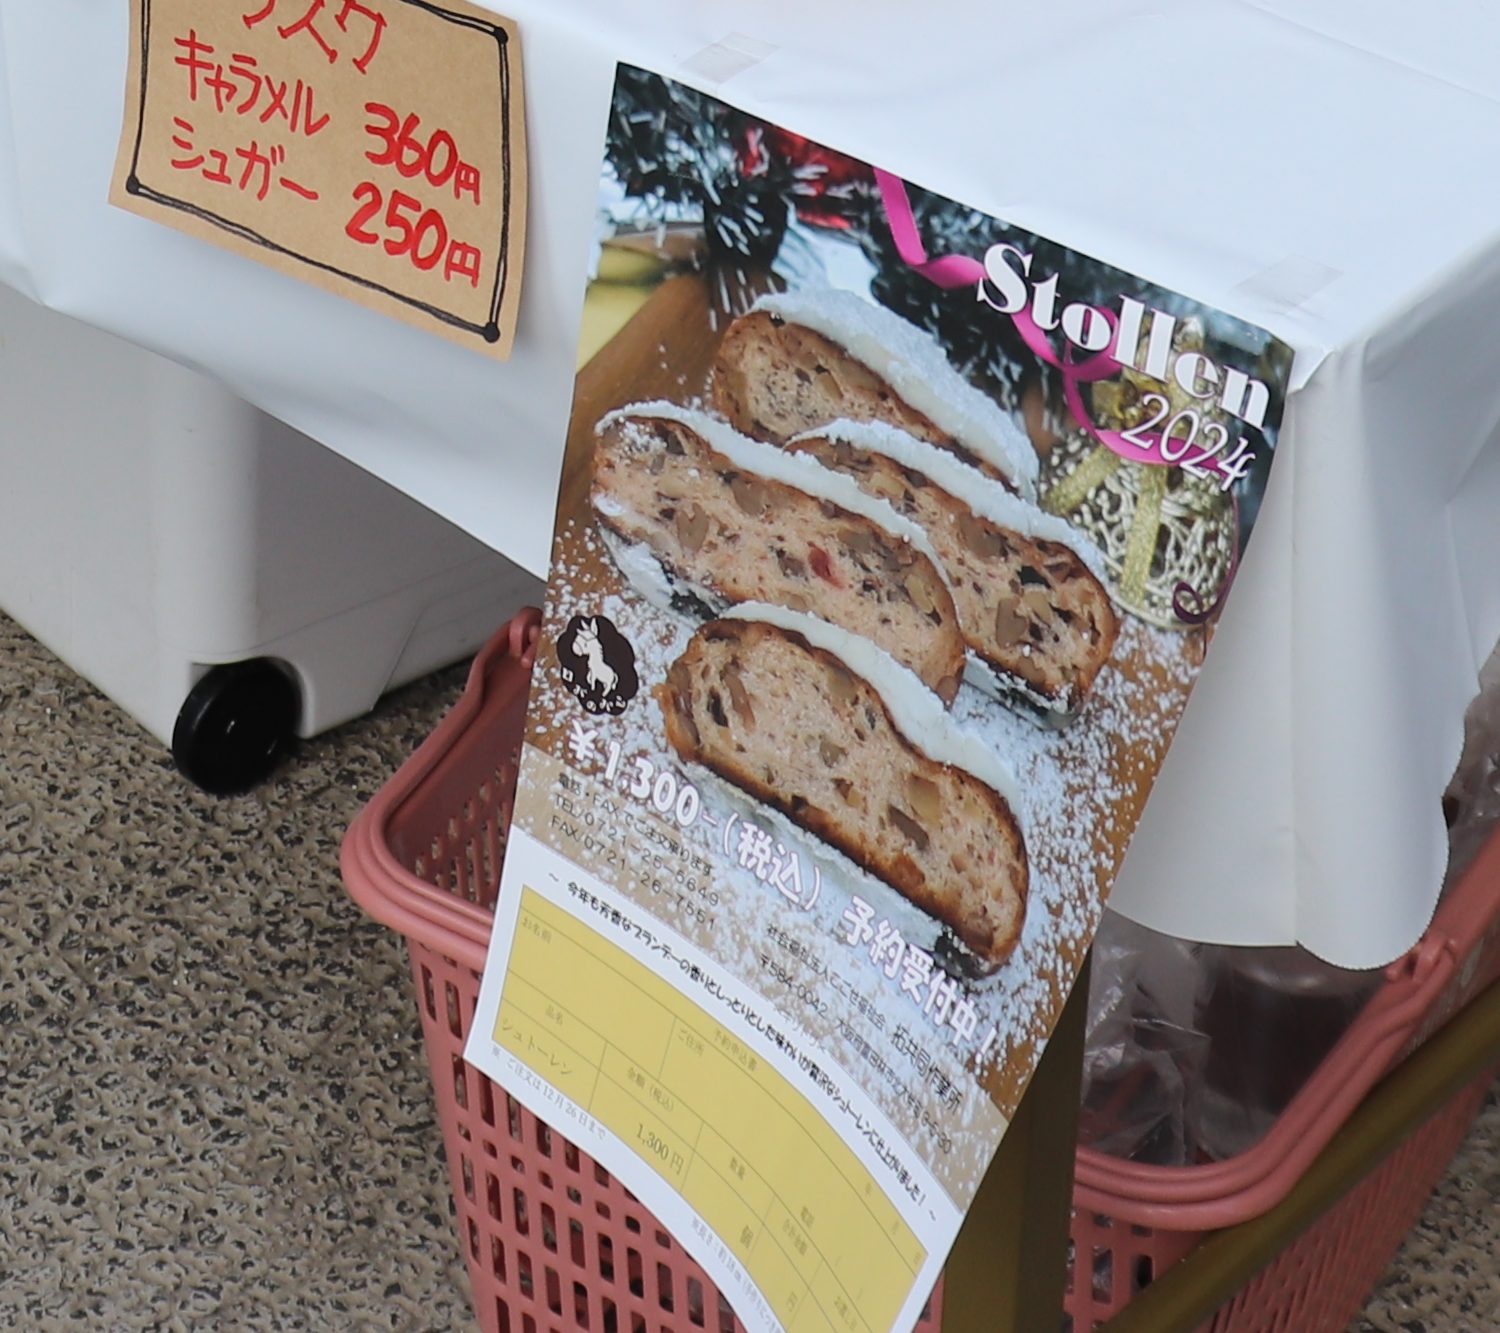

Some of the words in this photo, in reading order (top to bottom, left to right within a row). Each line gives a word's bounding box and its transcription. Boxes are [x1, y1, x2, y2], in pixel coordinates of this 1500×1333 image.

[171, 116, 319, 201] シュガー
[344, 181, 482, 288] 250円
[174, 29, 330, 135] キャラメル
[364, 101, 481, 206] 360円
[975, 241, 1276, 432] Stollen
[1118, 393, 1260, 494] 2024
[502, 1019, 574, 1077] シュトーレン
